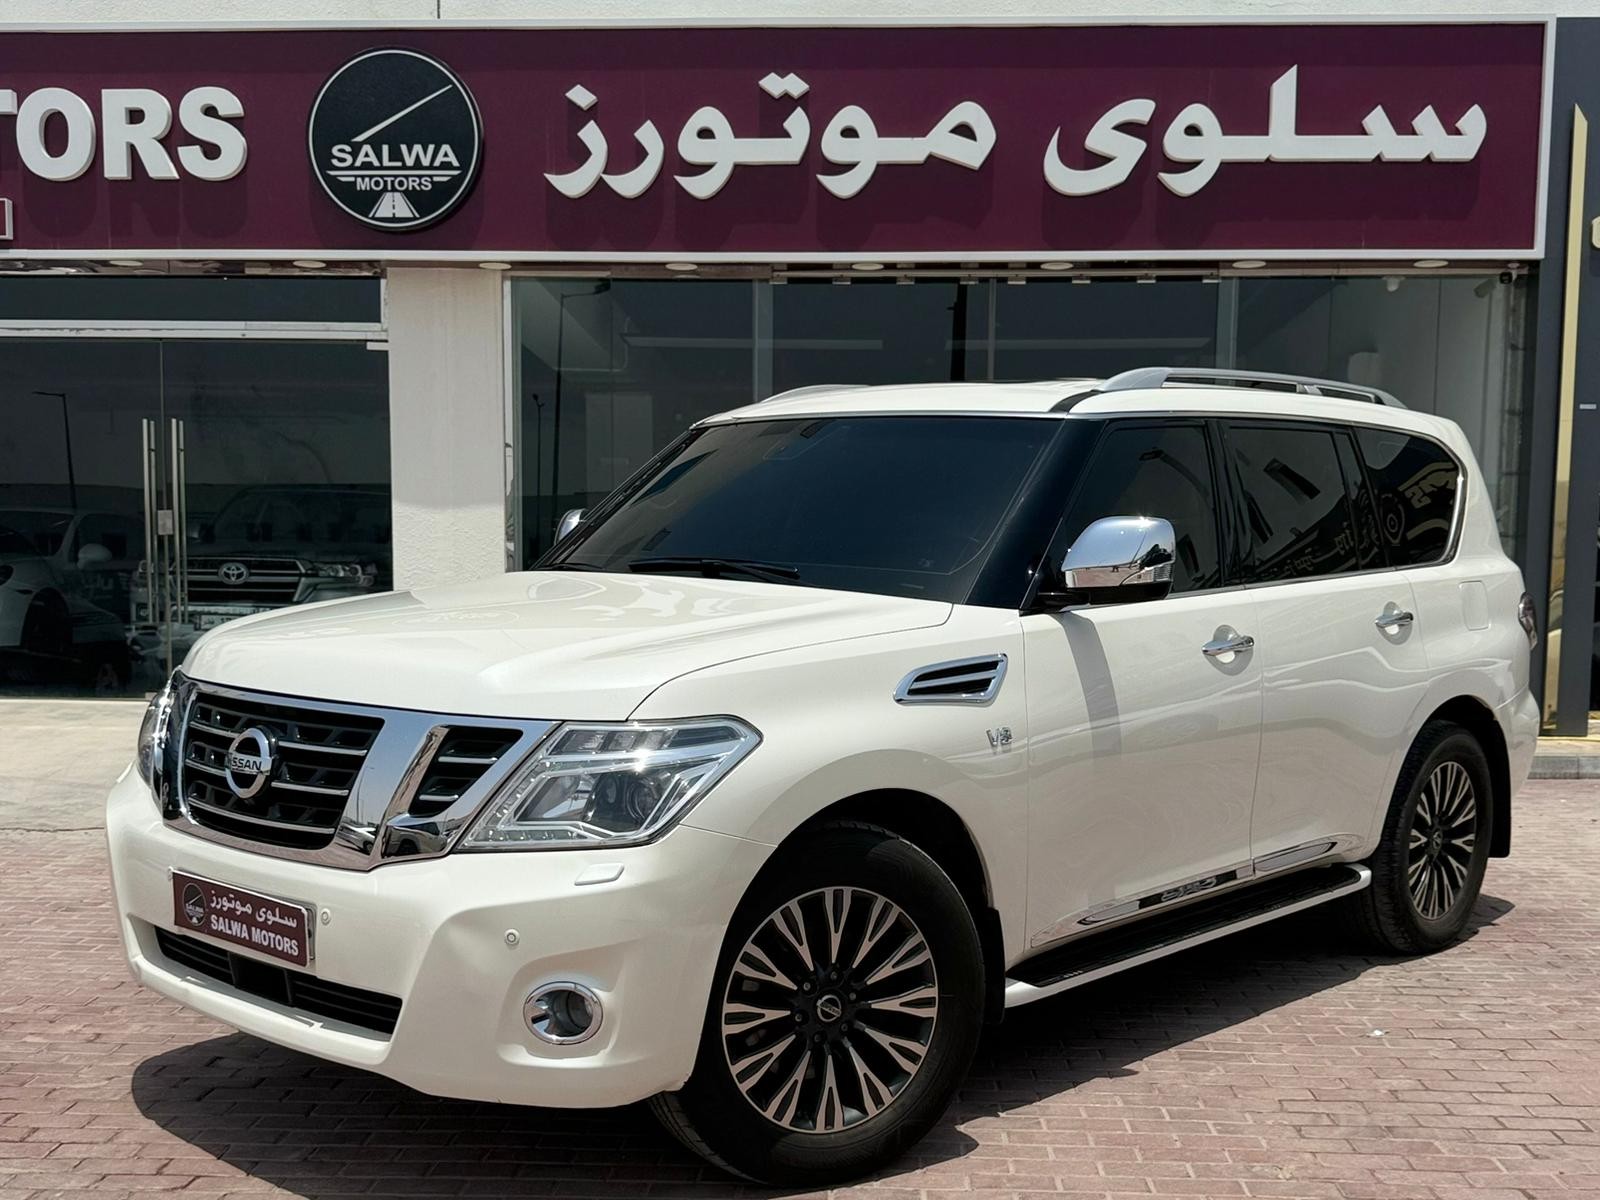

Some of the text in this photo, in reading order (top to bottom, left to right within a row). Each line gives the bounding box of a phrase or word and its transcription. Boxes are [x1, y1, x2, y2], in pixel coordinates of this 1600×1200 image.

[0, 86, 248, 181] ORS
[544, 64, 1487, 199] سلوى موتورز
[330, 143, 460, 168] SALWA
[356, 176, 433, 191] MOTORS
[210, 889, 297, 928] سلوى موتورز
[210, 914, 299, 956] SALWA MOTORS
